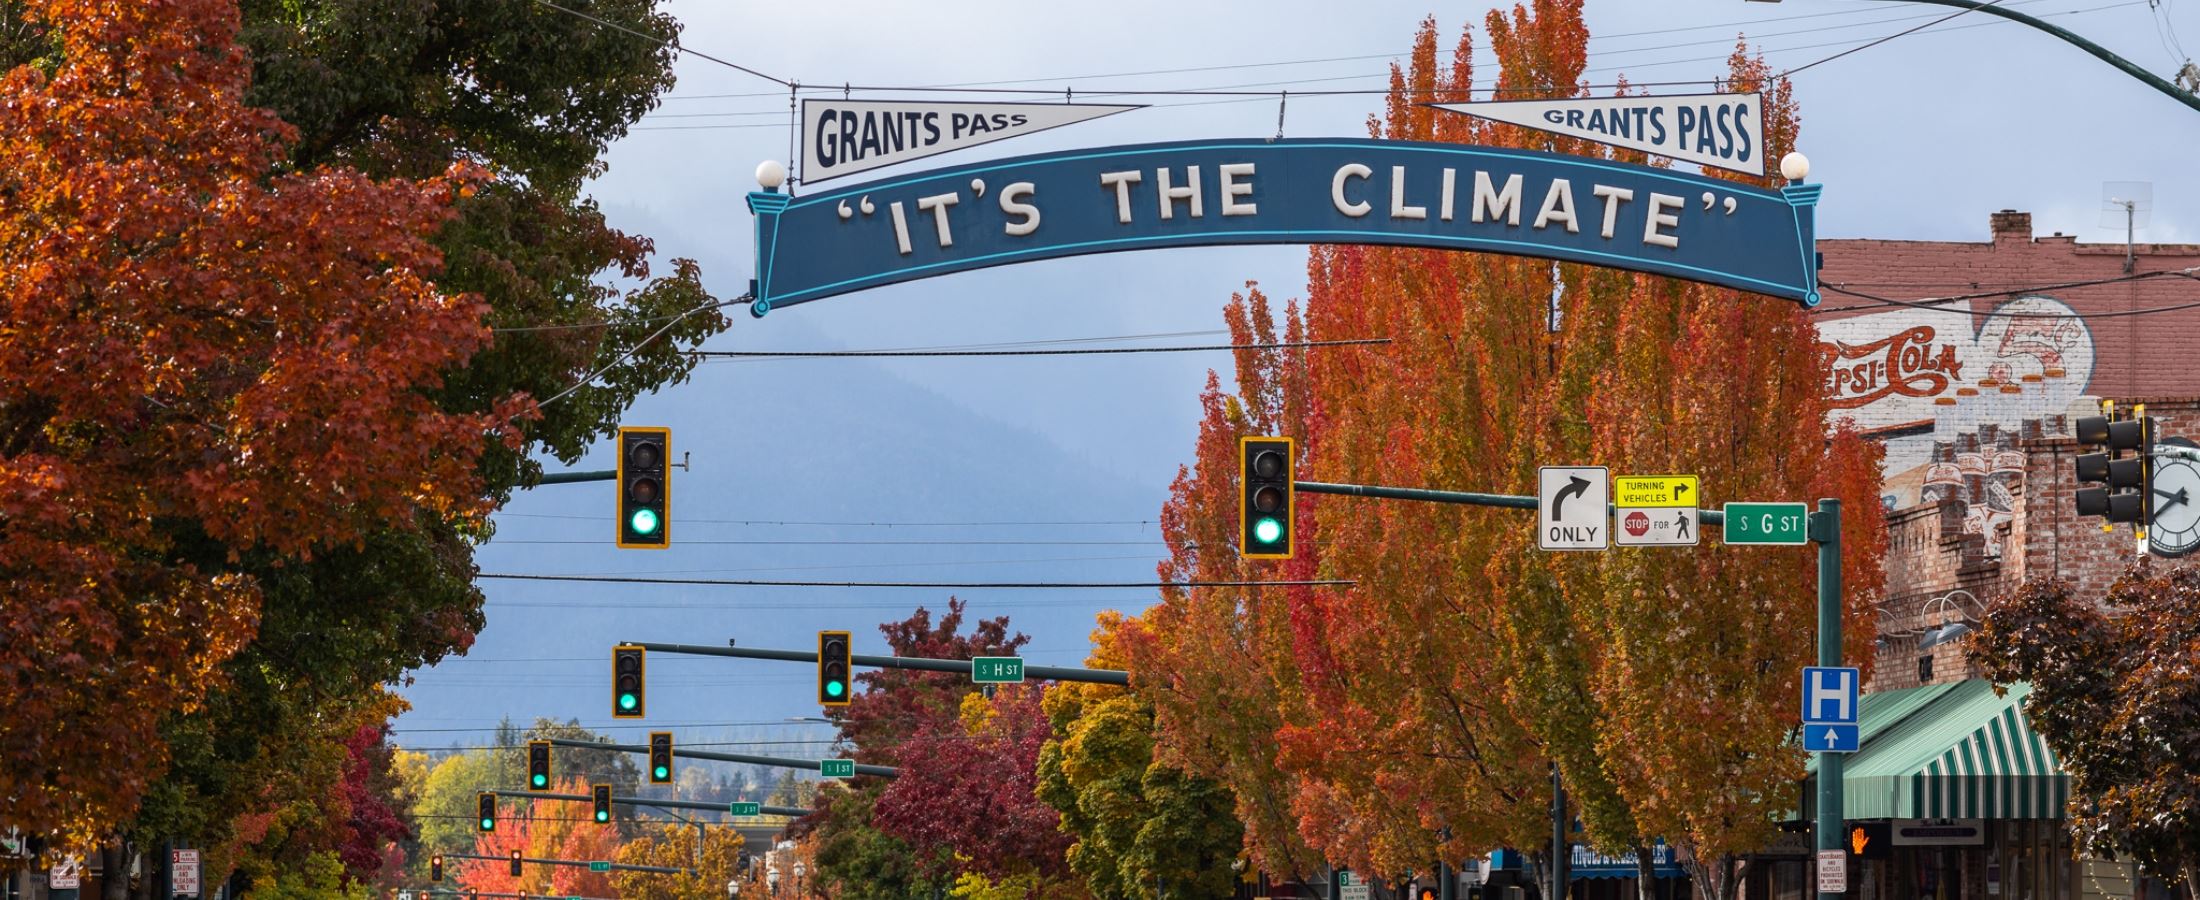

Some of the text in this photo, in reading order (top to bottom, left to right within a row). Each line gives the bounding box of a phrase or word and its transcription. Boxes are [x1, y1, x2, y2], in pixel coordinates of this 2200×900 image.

[816, 108, 1028, 168] GRANTS PASS
[1543, 103, 1751, 163] GRANTS PASS
[1101, 163, 1257, 223] THE
[1625, 481, 1665, 491] TURNING
[1623, 494, 1667, 503] VEHICLES
[1625, 518, 1669, 530] STOP FOR
[1740, 513, 1799, 534] S G ST
[1550, 526, 1598, 542] ONLY
[982, 663, 1018, 676] S H ST
[1811, 671, 1850, 720] H
[841, 764, 850, 772] ST
[743, 805, 748, 813] J
[1342, 874, 1347, 885] 3
